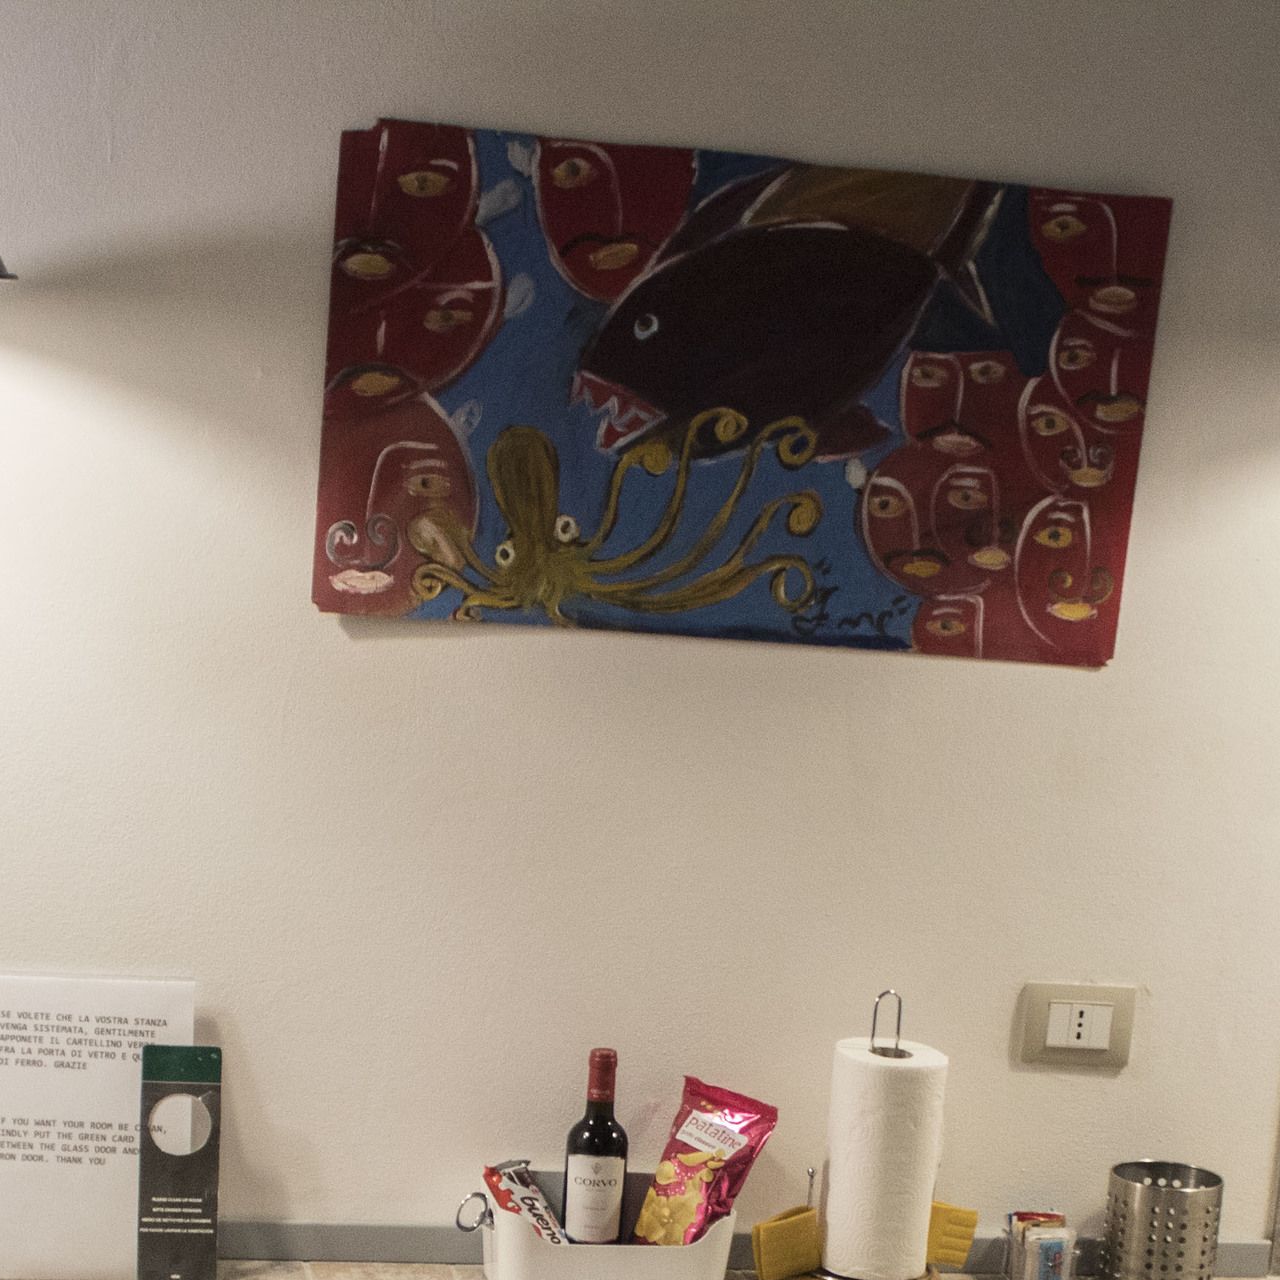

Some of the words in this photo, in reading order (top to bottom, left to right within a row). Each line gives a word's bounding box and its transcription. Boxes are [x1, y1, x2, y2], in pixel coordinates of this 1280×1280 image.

[0, 1010, 11, 1018] SE
[17, 1011, 51, 1020] VOLETE
[56, 1013, 72, 1021] CHE
[78, 1015, 90, 1023] LA
[95, 1015, 129, 1025] VOSTRA
[134, 1018, 168, 1027] STANZA
[0, 1023, 27, 1031] VENGA
[33, 1024, 88, 1036] SISTEMATA,
[94, 1027, 156, 1038] GENTILMENTE
[0, 1034, 44, 1044] APPONETE
[50, 1036, 60, 1045] IL
[66, 1037, 122, 1048] CARTELLINO
[0, 1046, 15, 1054] FRA
[21, 1047, 32, 1055] LA
[38, 1048, 66, 1057] PORTA
[71, 1049, 82, 1058] DI
[88, 1050, 116, 1060] VETRO
[15, 1058, 47, 1068] FERRO.
[54, 1060, 87, 1070] GRAZIE
[12, 1117, 29, 1126] YOU
[34, 1119, 57, 1127] WANT
[62, 1120, 84, 1128] YOUR
[90, 1121, 113, 1130] ROOM
[118, 1123, 128, 1131] BE
[33, 1130, 50, 1139] PUT
[57, 1131, 73, 1140] THE
[78, 1132, 107, 1142] GREEN
[112, 1134, 135, 1143] CARD
[40, 1142, 56, 1151] THE
[61, 1143, 89, 1153] GLASS
[94, 1145, 117, 1154] DOOR
[56, 1155, 83, 1164] THANK
[89, 1157, 106, 1166] YOU
[573, 1175, 618, 1188] CORVO
[519, 1195, 562, 1245] bueno
